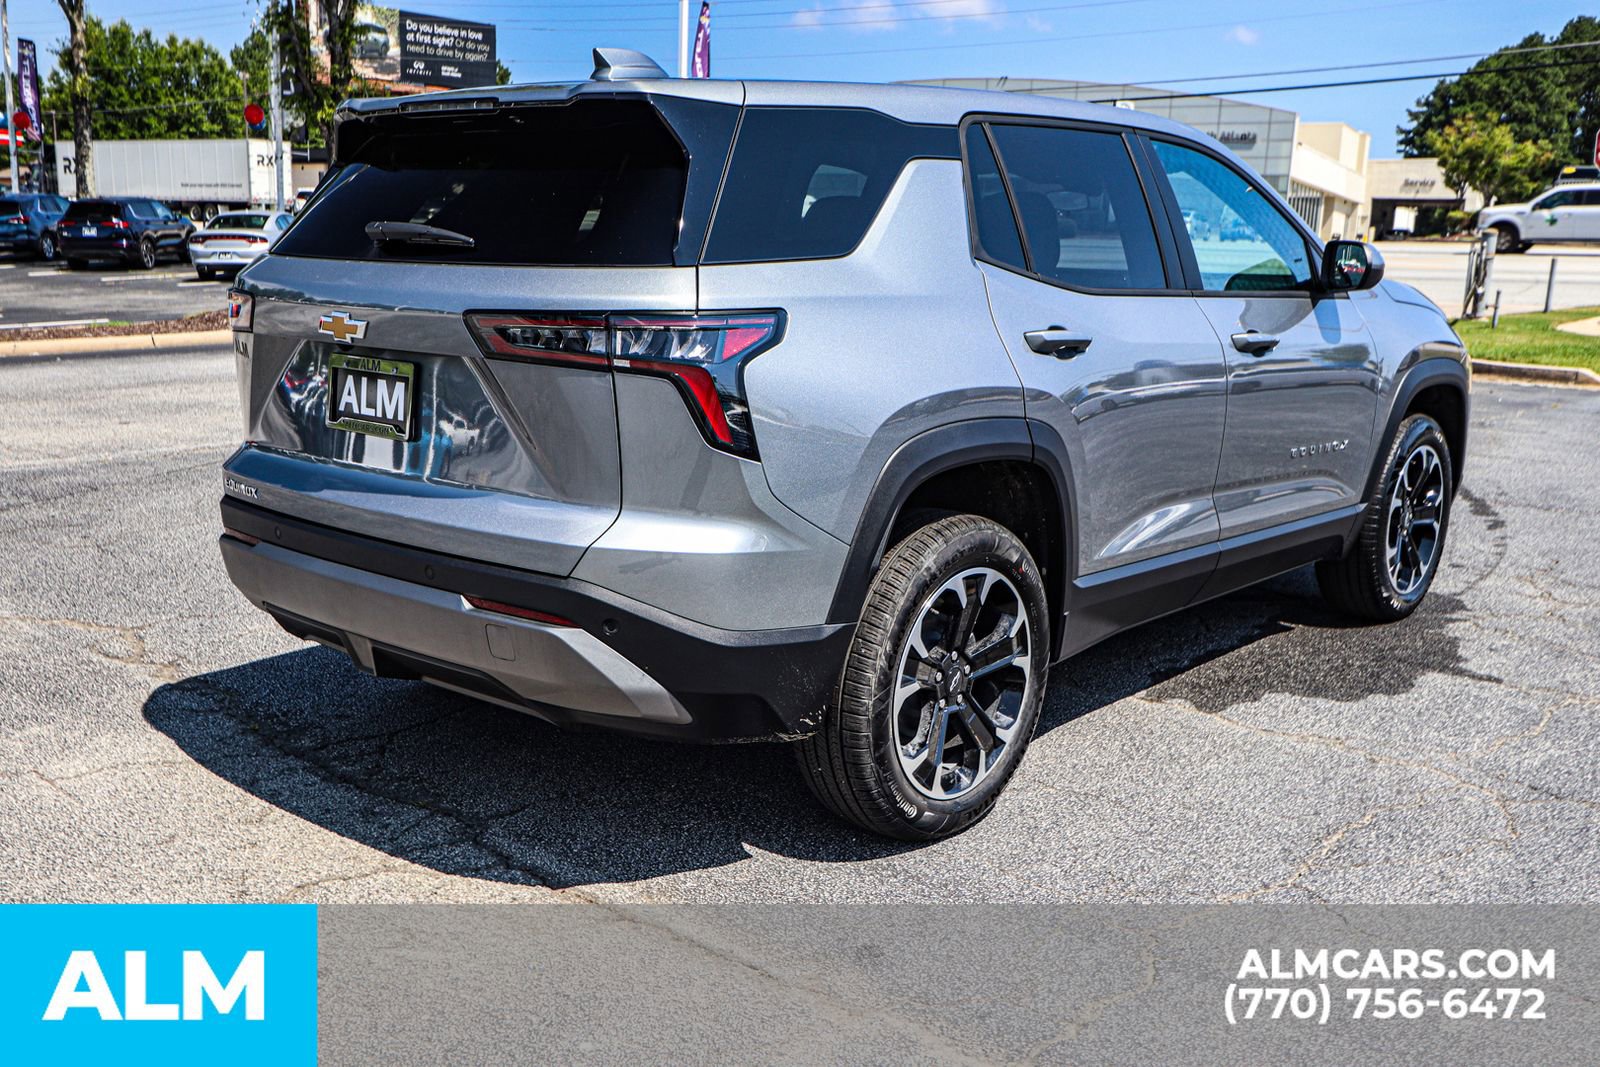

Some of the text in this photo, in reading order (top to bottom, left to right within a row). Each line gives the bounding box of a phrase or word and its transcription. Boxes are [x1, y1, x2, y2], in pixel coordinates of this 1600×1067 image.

[406, 20, 482, 40] Do you believe in love
[406, 32, 490, 52] at first sight? Or do you
[406, 44, 488, 62] need to drive by again?
[359, 359, 381, 372] ALM
[338, 375, 405, 422] ALM
